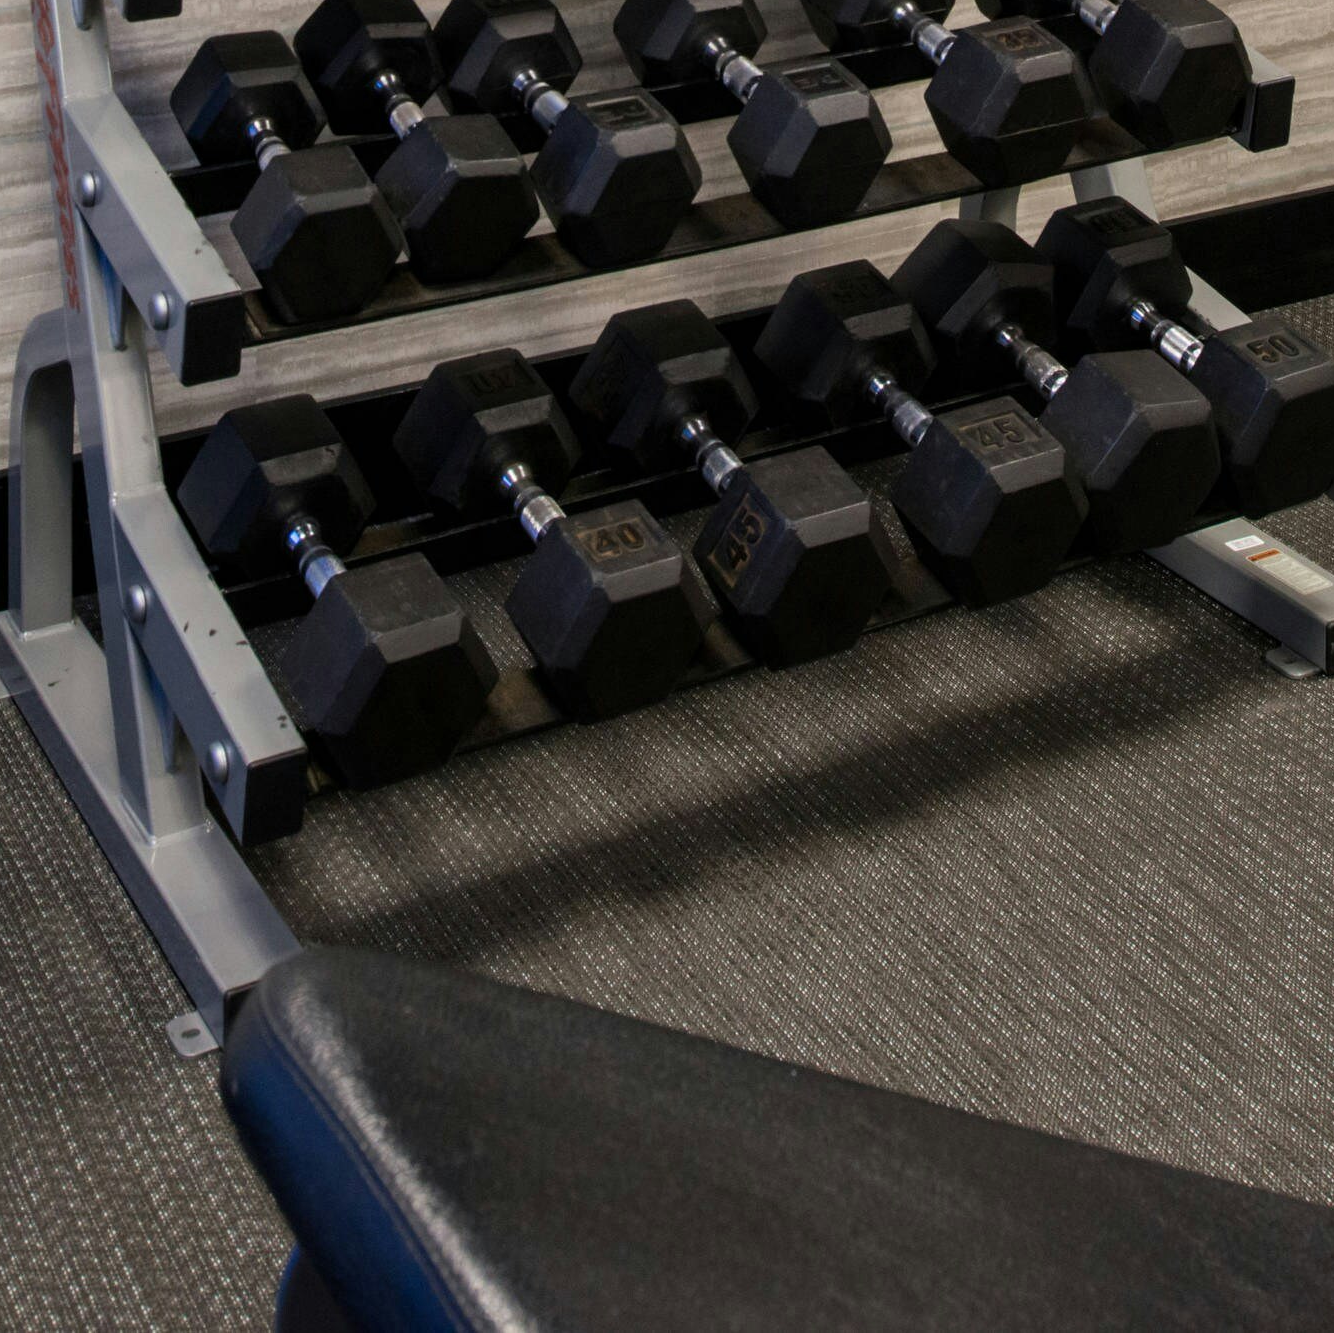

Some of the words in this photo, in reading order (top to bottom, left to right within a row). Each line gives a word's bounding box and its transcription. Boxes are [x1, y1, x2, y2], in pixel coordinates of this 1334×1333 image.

[1246, 333, 1300, 364] 50
[978, 418, 1025, 450] 45
[595, 521, 645, 556] 40
